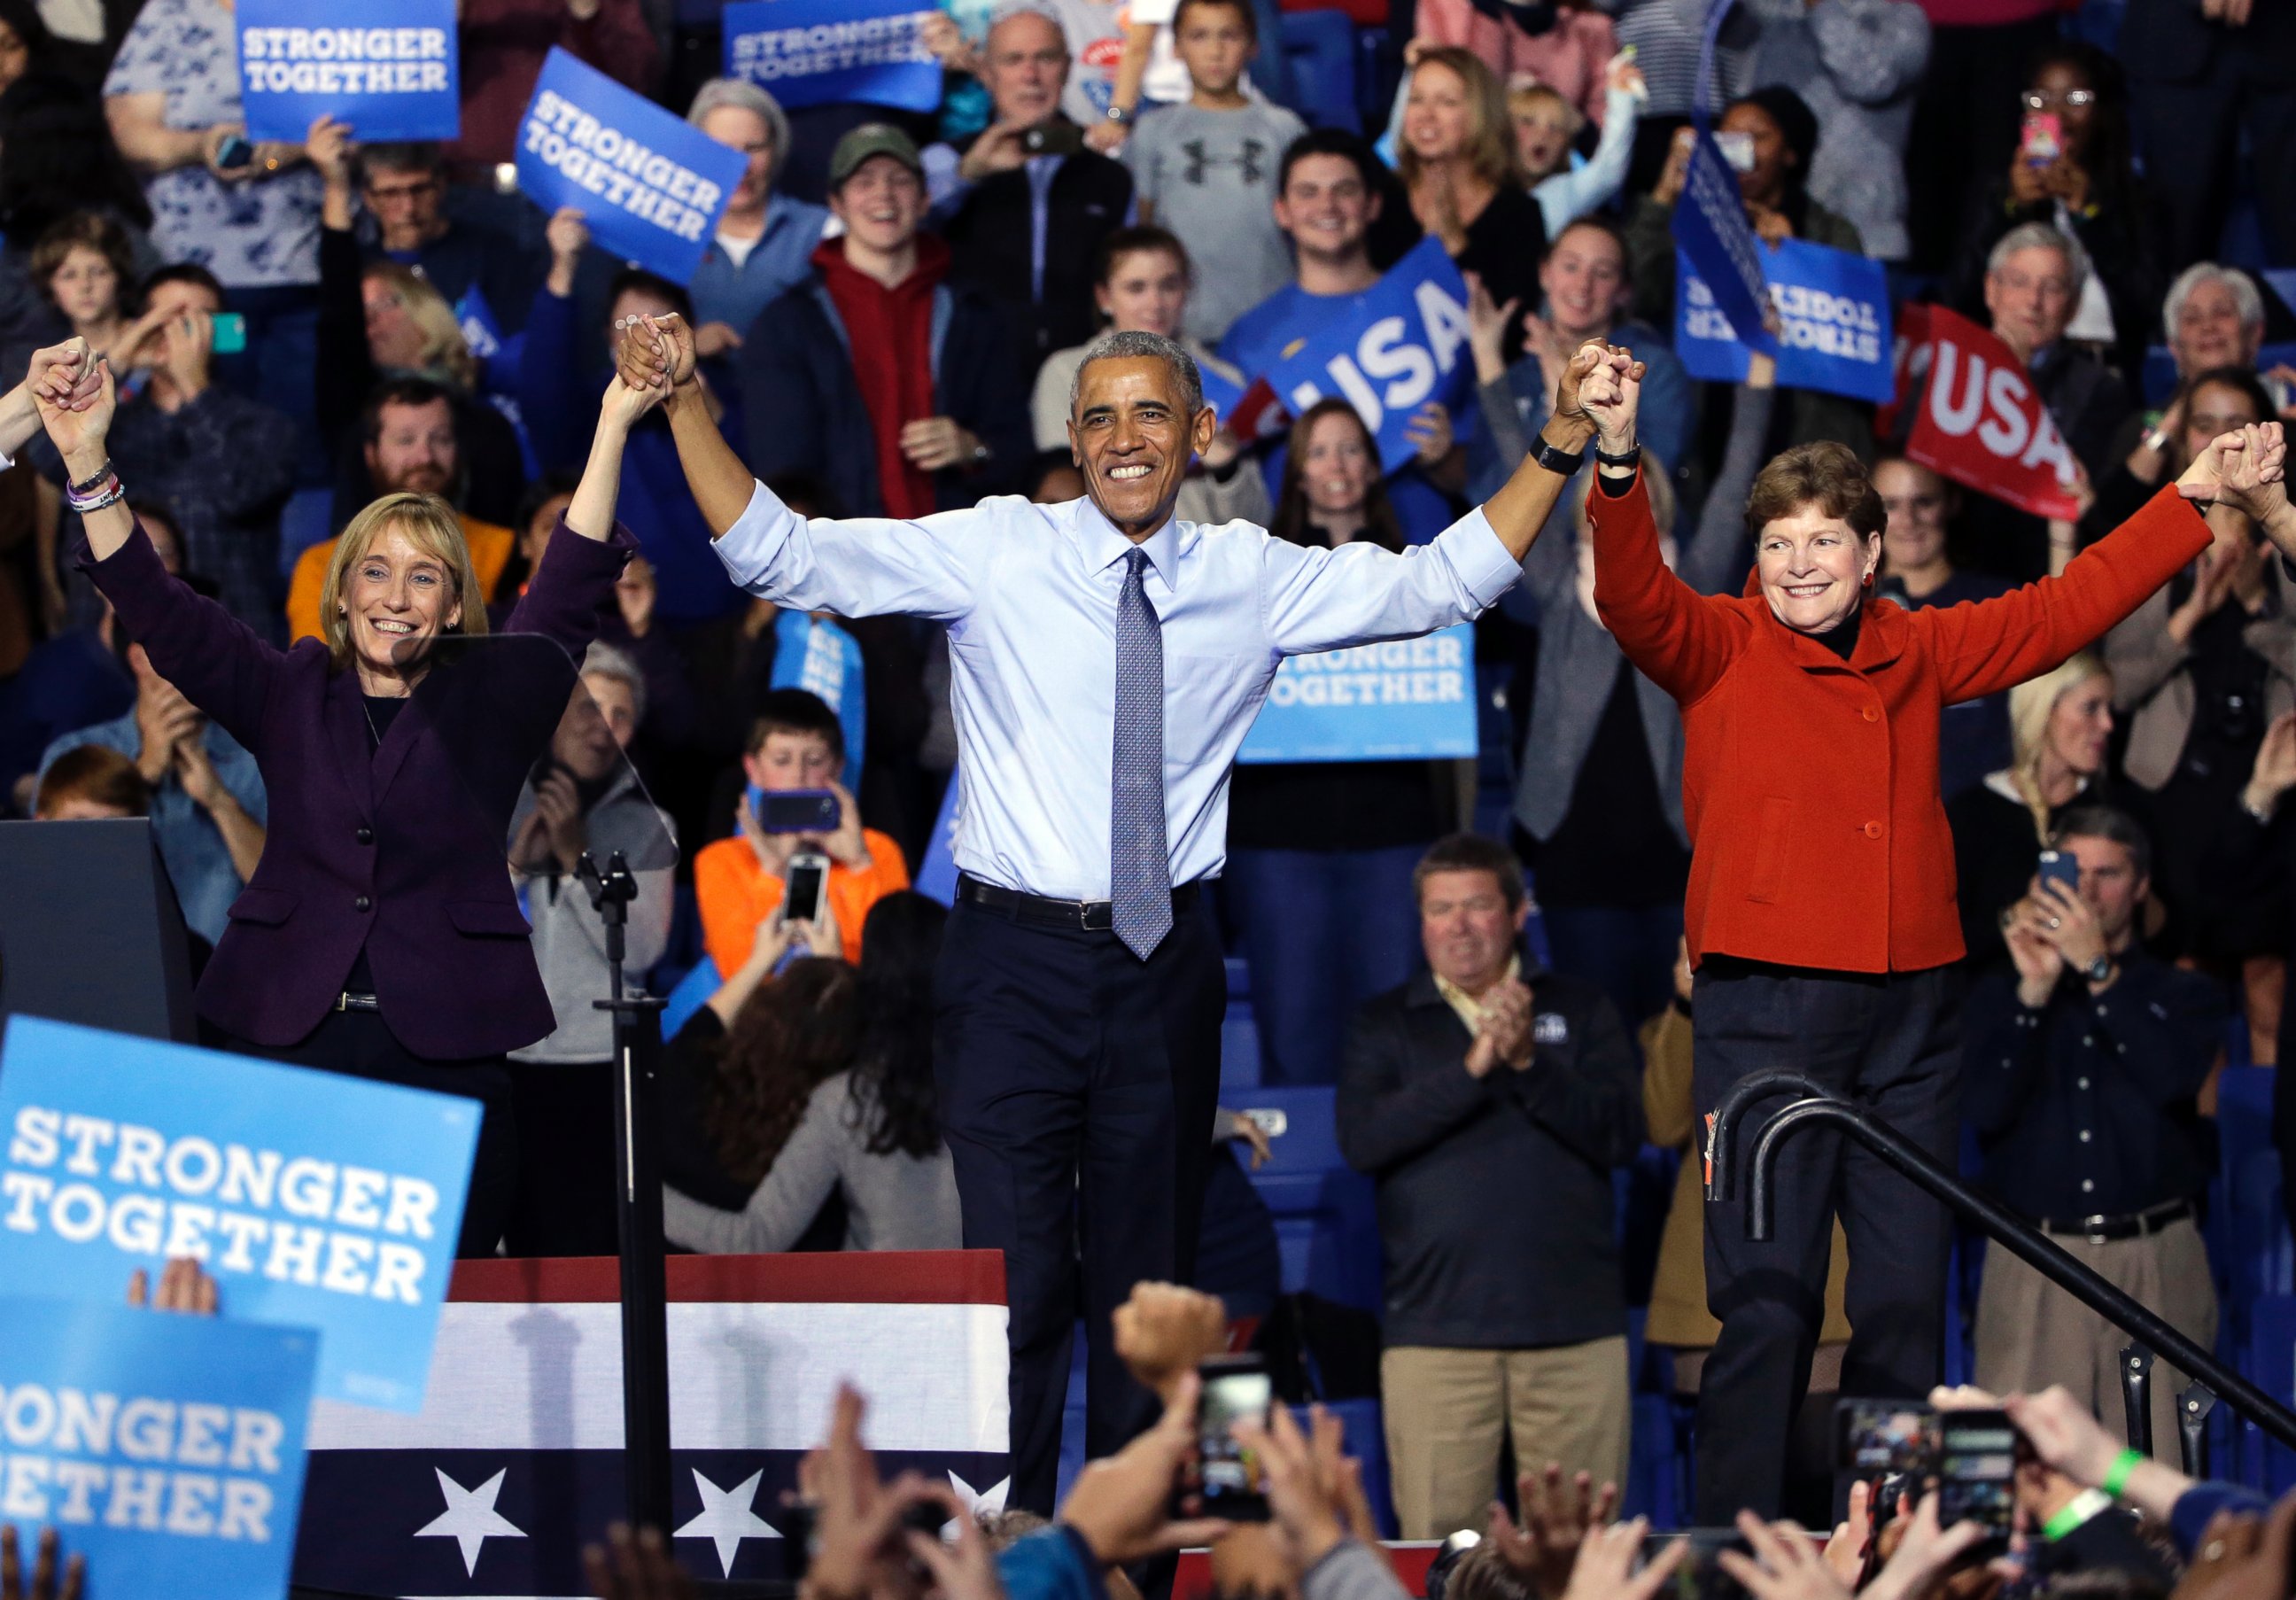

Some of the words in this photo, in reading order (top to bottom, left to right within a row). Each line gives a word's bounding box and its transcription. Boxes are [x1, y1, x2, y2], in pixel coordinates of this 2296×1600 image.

[243, 27, 446, 59] STRONGER
[244, 60, 448, 93] TOGETHER
[524, 118, 707, 243] TOGETHER
[533, 89, 721, 214] STRONGER
[1929, 338, 2076, 486] USA
[1269, 670, 1465, 707] OGETHER
[10, 1105, 438, 1239] STRONGER
[3, 1170, 426, 1306] TOGETHER
[0, 1383, 284, 1474] ONGER
[0, 1455, 274, 1543] ETHER
